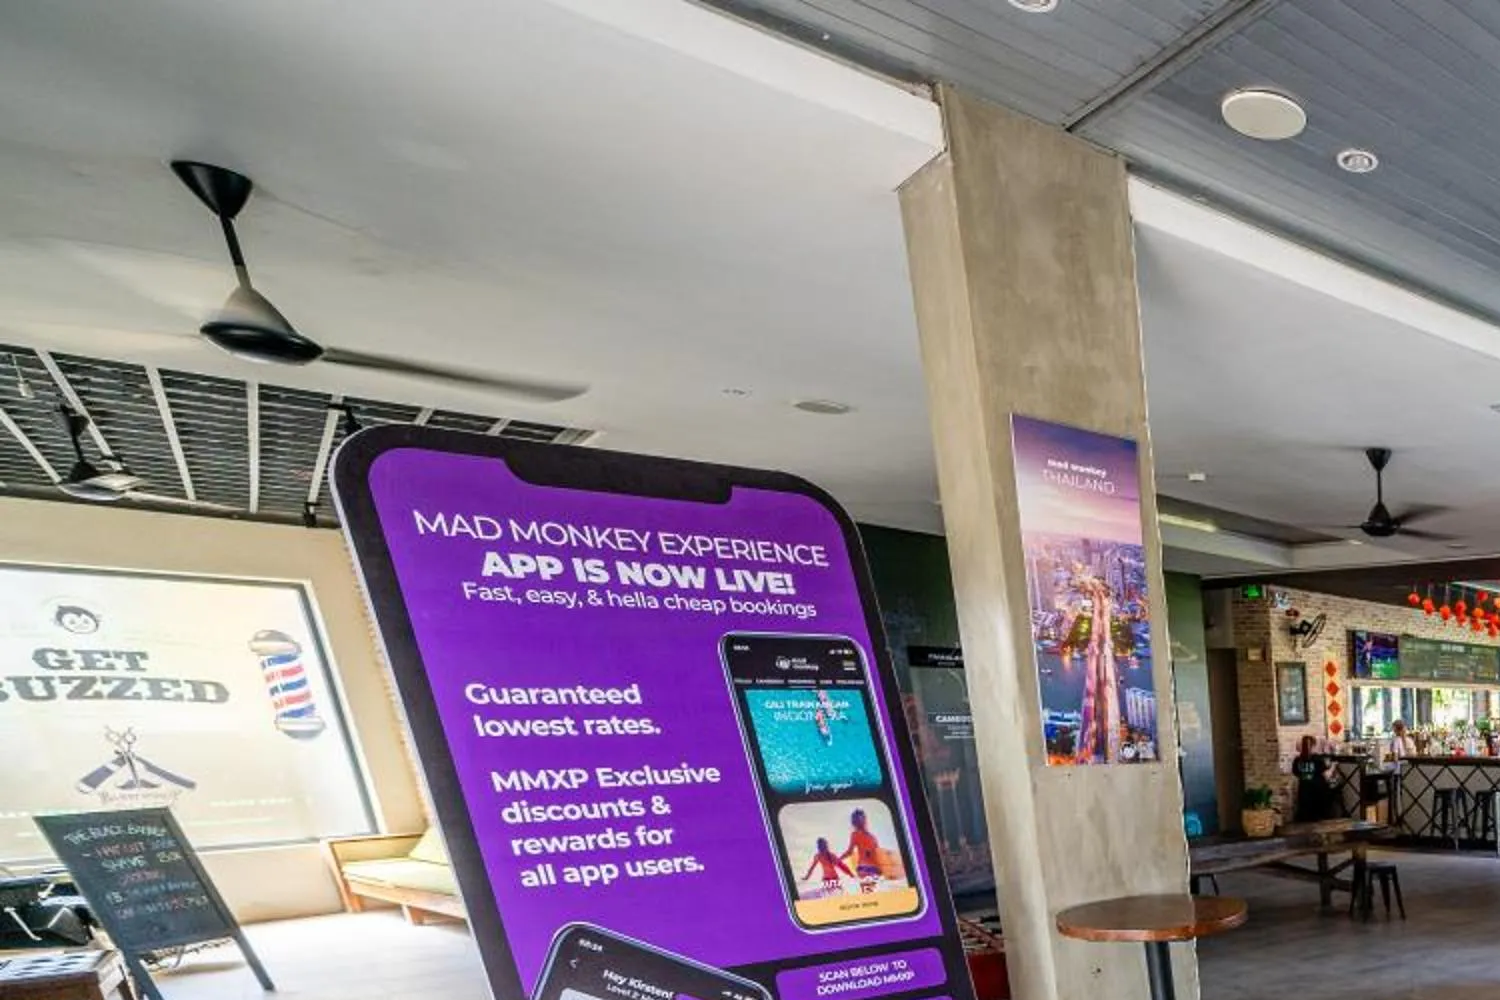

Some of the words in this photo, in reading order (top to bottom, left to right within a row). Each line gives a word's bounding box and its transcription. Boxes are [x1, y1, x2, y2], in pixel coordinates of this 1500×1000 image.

[413, 509, 502, 540] MAD
[508, 519, 651, 552] MONKEY
[658, 531, 830, 567] EXPERIENCE
[481, 551, 564, 580] APP
[572, 557, 610, 584] IS
[615, 560, 706, 589] NOW
[714, 567, 796, 595] LIVE!
[461, 581, 522, 605] Fast,
[525, 588, 583, 609] easy,
[587, 589, 603, 606] &
[606, 590, 660, 609] hella
[663, 593, 727, 615] cheap
[729, 596, 817, 619] bookings
[31, 647, 149, 672] GET
[0, 675, 230, 703] UZZED
[465, 683, 643, 705] Guaranteed
[473, 714, 578, 737] lowest
[583, 716, 662, 736] rates.
[491, 769, 589, 792] MMXP
[595, 762, 722, 788] Exclusive
[501, 798, 646, 824] discounts
[650, 795, 672, 815] &
[511, 827, 632, 856] rewards
[635, 825, 674, 846] for
[520, 863, 557, 887] all
[562, 862, 619, 887] app
[625, 855, 705, 877] users.
[603, 969, 628, 986] Hey
[818, 967, 849, 983] SCAN
[850, 961, 889, 978] BELOW
[892, 960, 907, 971] TO
[816, 976, 883, 996] DOWNLOAD
